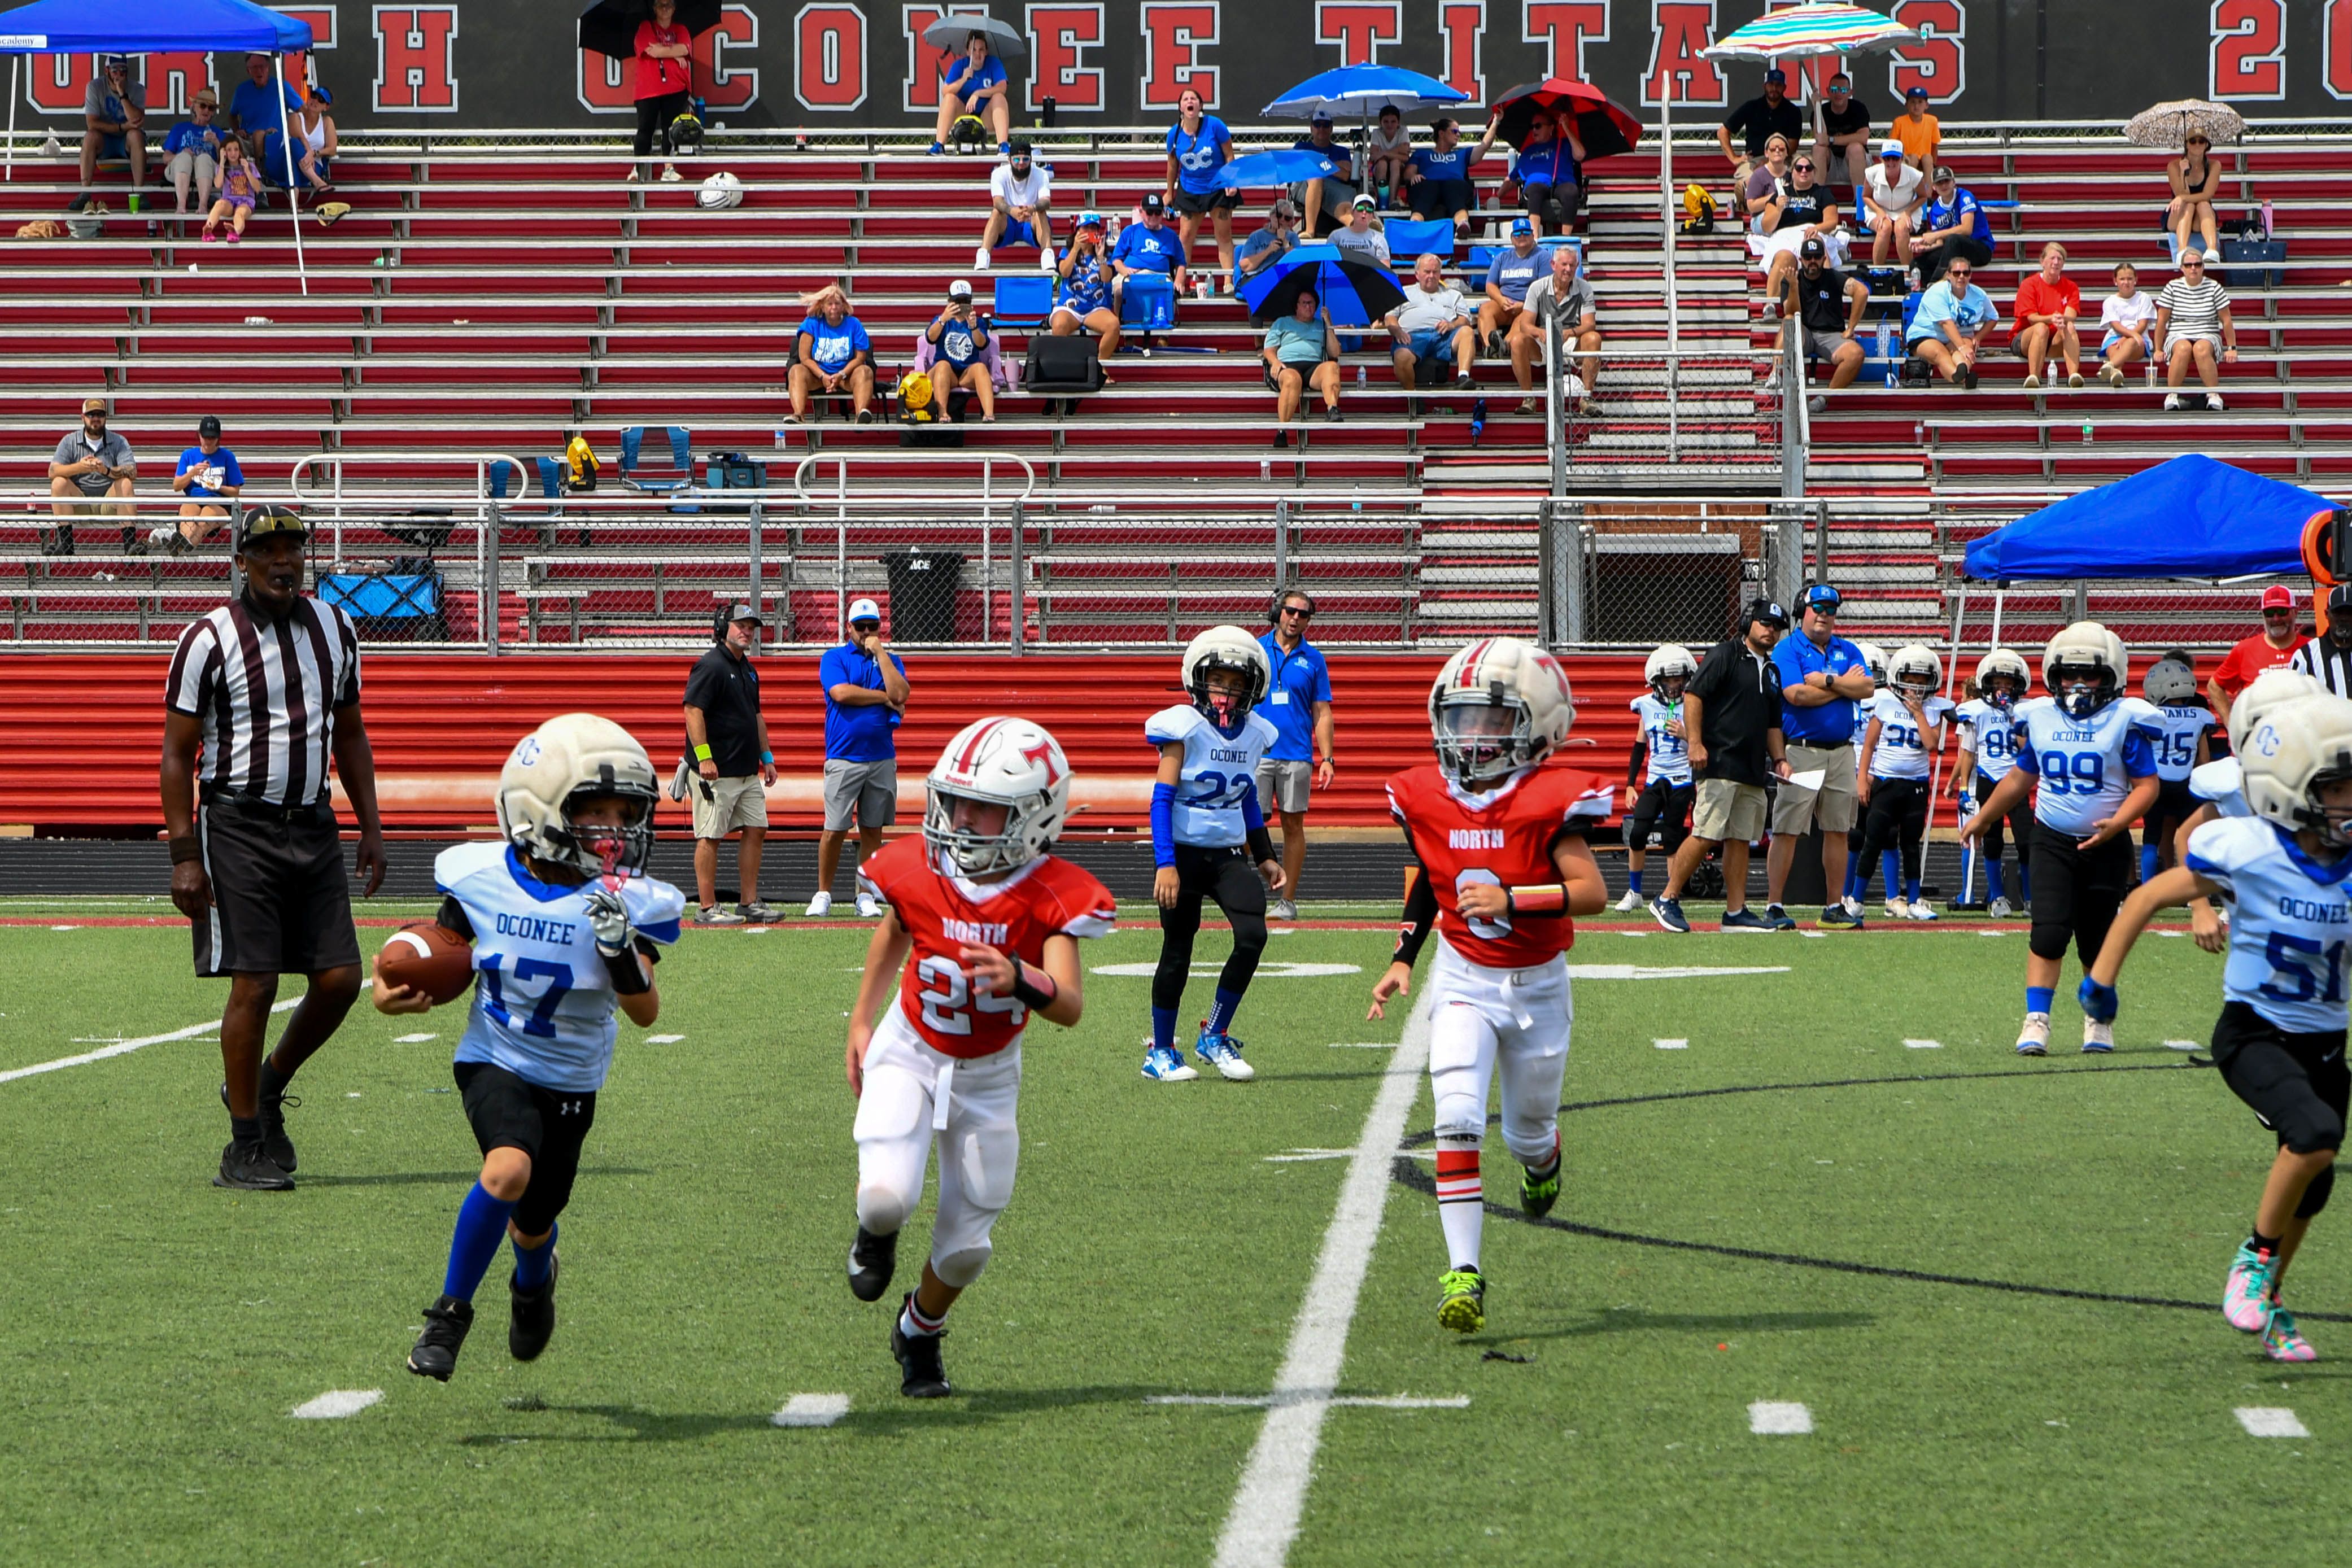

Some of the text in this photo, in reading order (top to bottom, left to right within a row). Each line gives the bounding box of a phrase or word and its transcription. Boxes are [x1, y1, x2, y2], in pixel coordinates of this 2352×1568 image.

[0, 36, 34, 46] cademy
[1180, 146, 1213, 171] OC
[1501, 268, 1533, 278] WARRIORS
[910, 559, 931, 570] ACE
[2052, 731, 2096, 742] OCONEE
[2158, 732, 2193, 766] 15
[1210, 749, 1247, 763] OCONEE
[2041, 750, 2104, 795] 99
[1186, 770, 1254, 810] 22
[1449, 829, 1504, 849] NORTH
[2279, 896, 2350, 924] OCONEE
[496, 912, 577, 946] OCONEE
[942, 917, 1009, 945] NORTH
[2259, 931, 2347, 1003] 51
[479, 952, 575, 1039] 17
